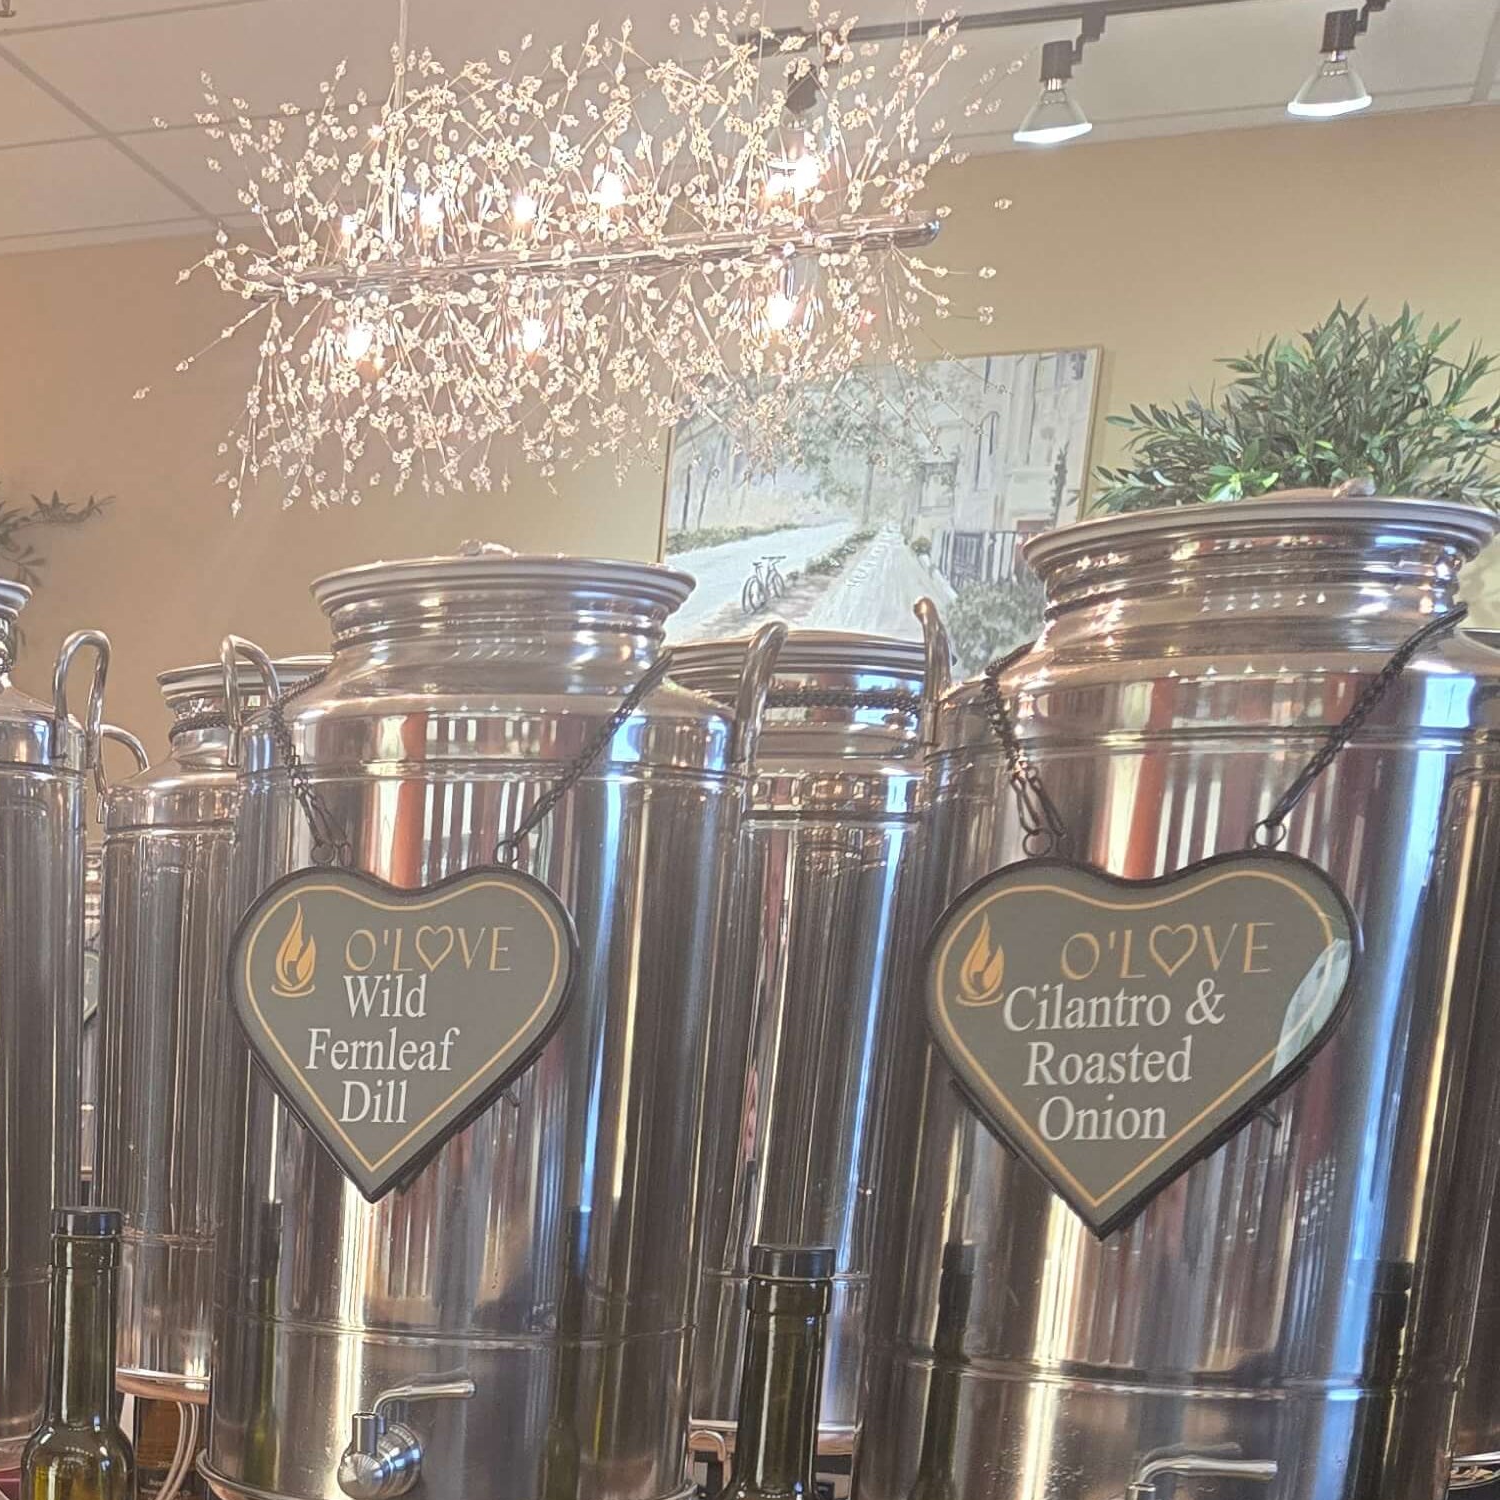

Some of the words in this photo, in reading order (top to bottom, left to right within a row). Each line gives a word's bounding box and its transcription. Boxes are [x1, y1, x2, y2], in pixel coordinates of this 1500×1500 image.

[343, 973, 427, 1018] Wild
[1002, 983, 1171, 1032] Cilantro
[1185, 978, 1225, 1026] &
[304, 1027, 460, 1071] Fernleaf
[1022, 1035, 1193, 1086] Roasted
[339, 1080, 408, 1123] Dill
[1038, 1093, 1167, 1141] Onion
